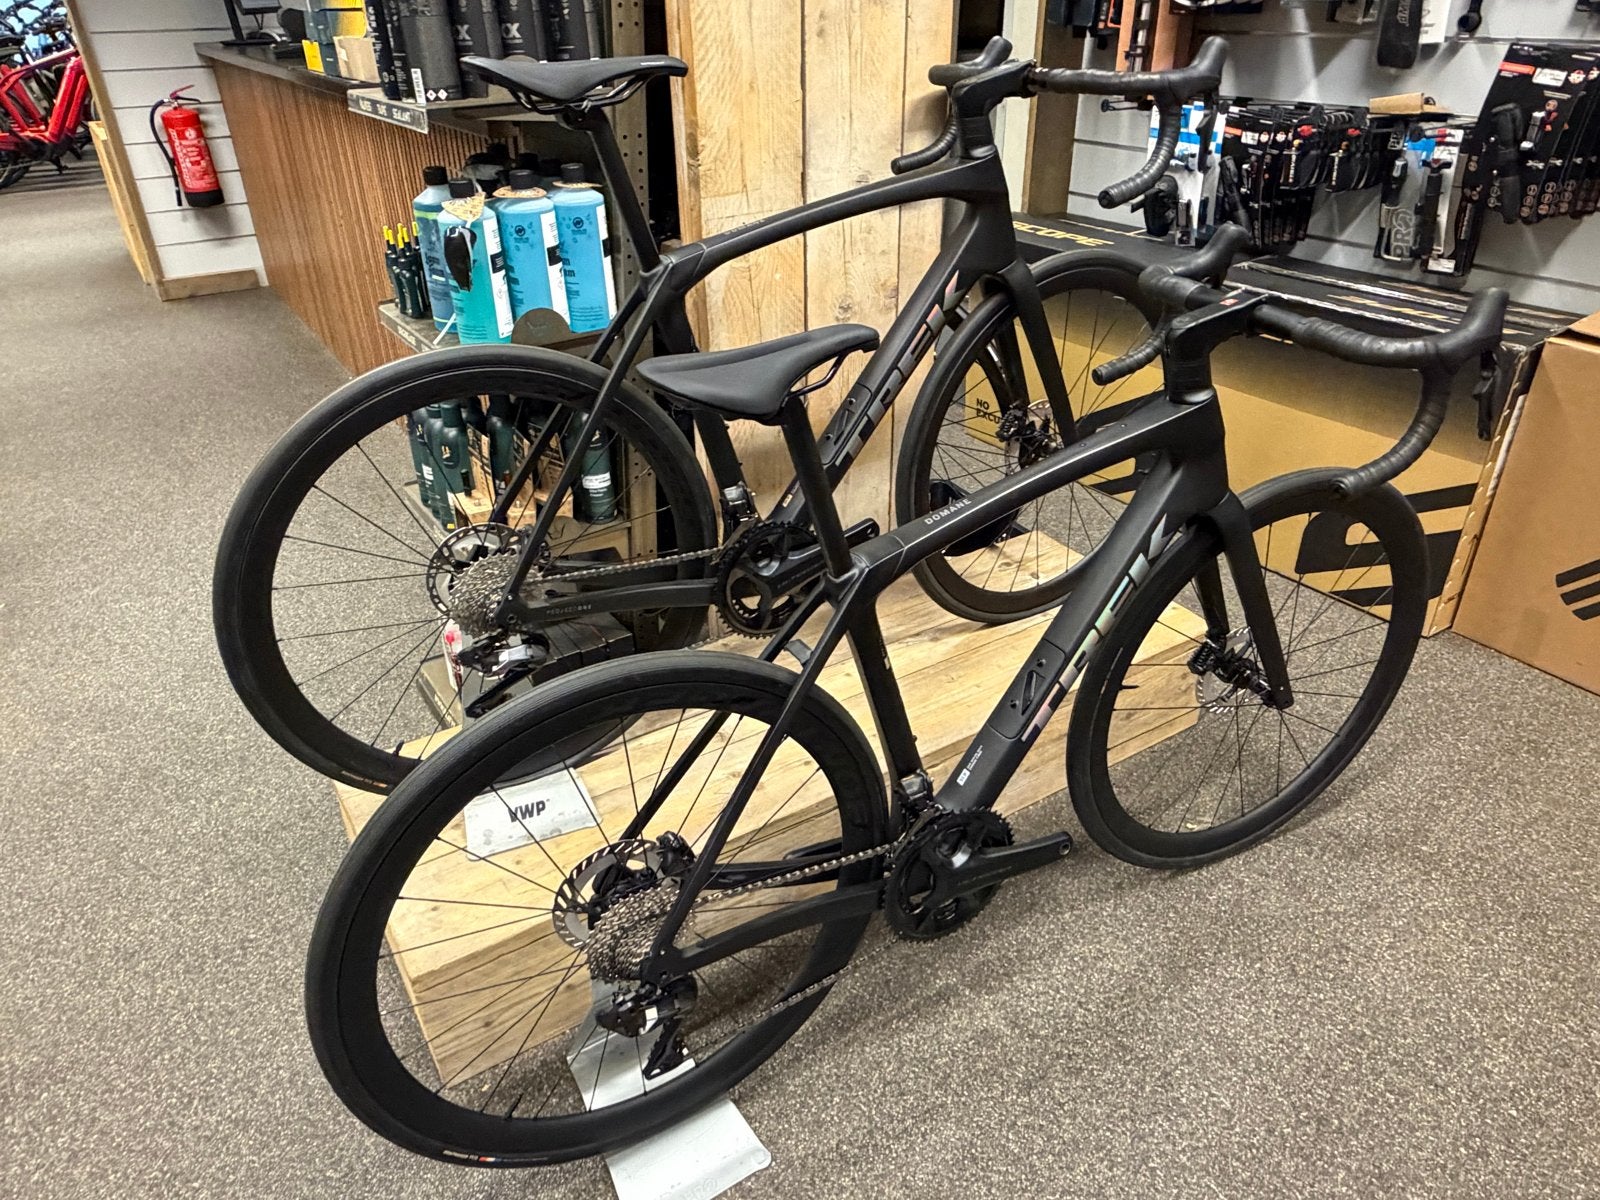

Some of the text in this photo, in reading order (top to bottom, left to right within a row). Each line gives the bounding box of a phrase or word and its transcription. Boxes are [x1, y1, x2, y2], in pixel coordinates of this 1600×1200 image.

[976, 397, 990, 411] NO
[924, 498, 972, 526] DOMANE
[1021, 512, 1180, 743] TREK
